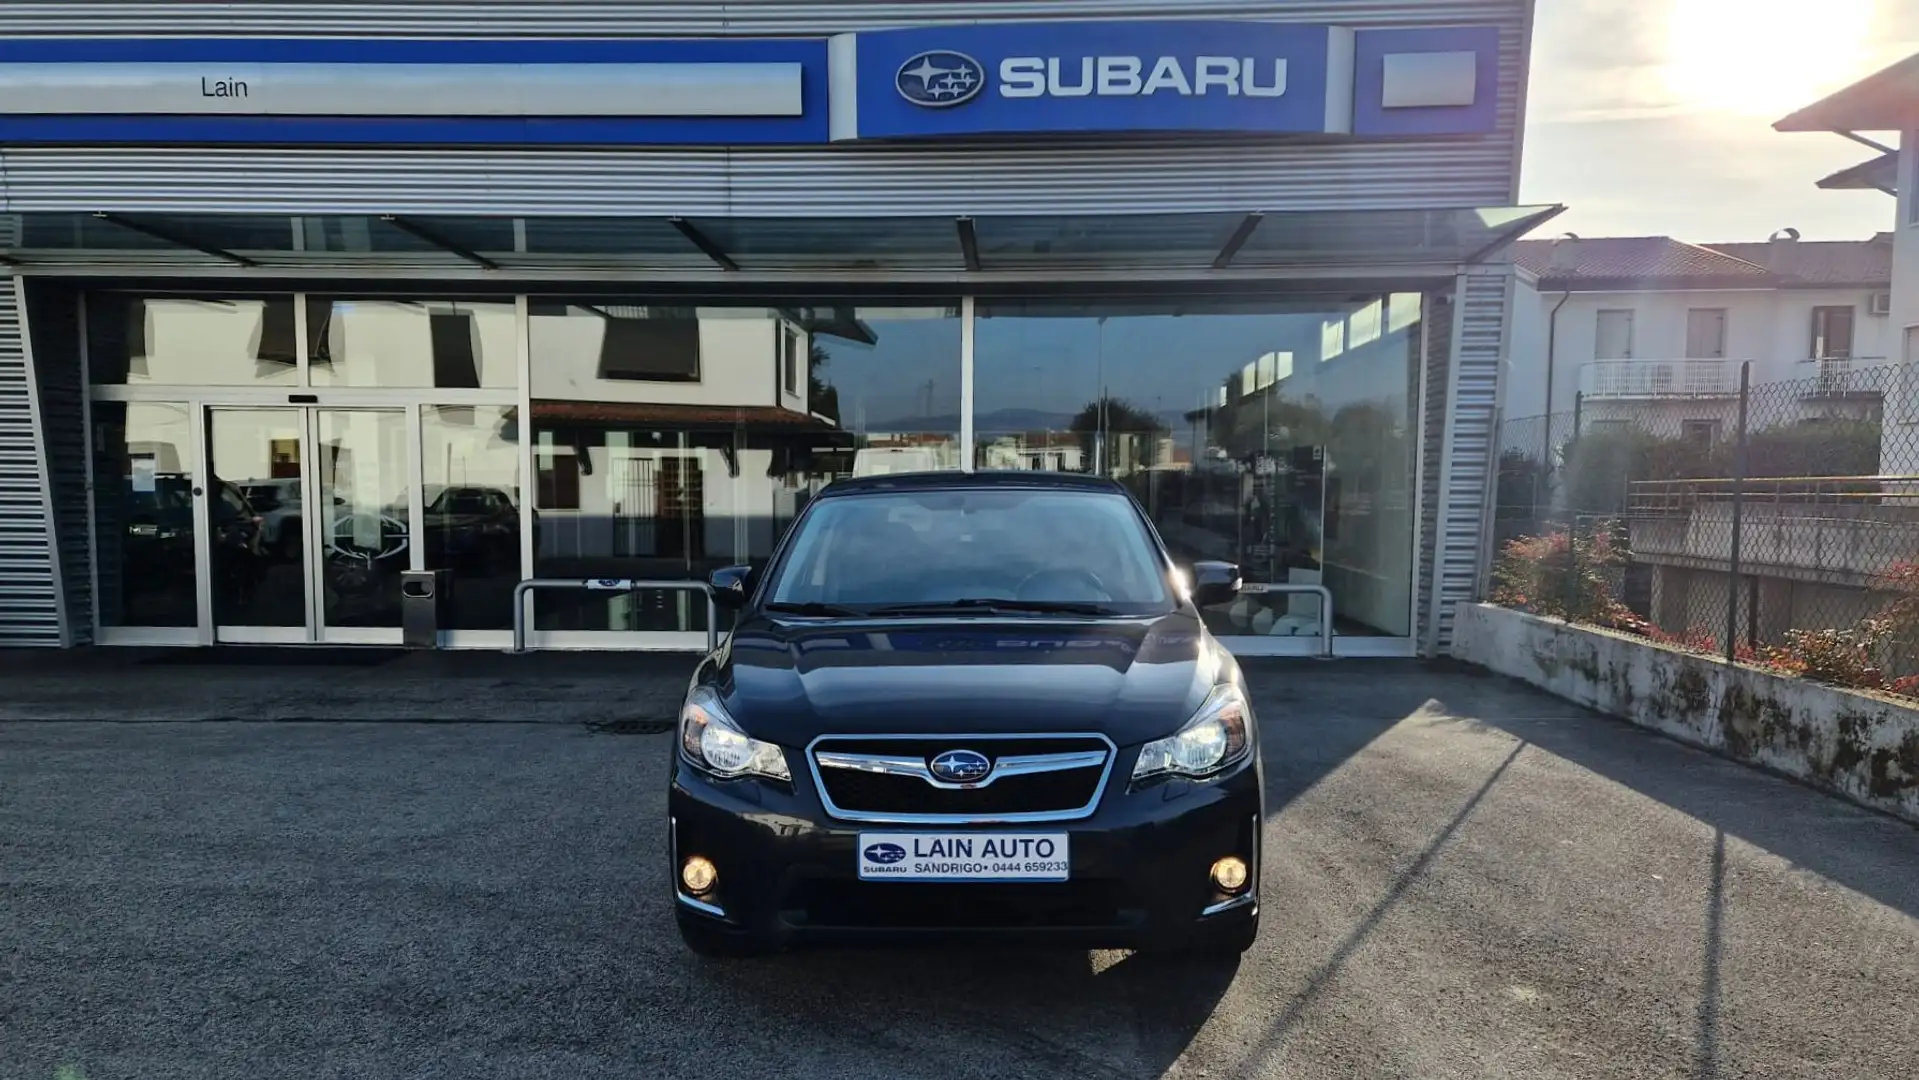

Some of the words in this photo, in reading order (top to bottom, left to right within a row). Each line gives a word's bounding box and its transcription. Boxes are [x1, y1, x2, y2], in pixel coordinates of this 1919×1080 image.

[201, 76, 248, 97] Lain
[999, 56, 1288, 98] SUBARU
[914, 838, 973, 858] LAIN
[981, 838, 1055, 858] AUTO
[992, 862, 1021, 873] 0444
[1024, 861, 1068, 872] 659233
